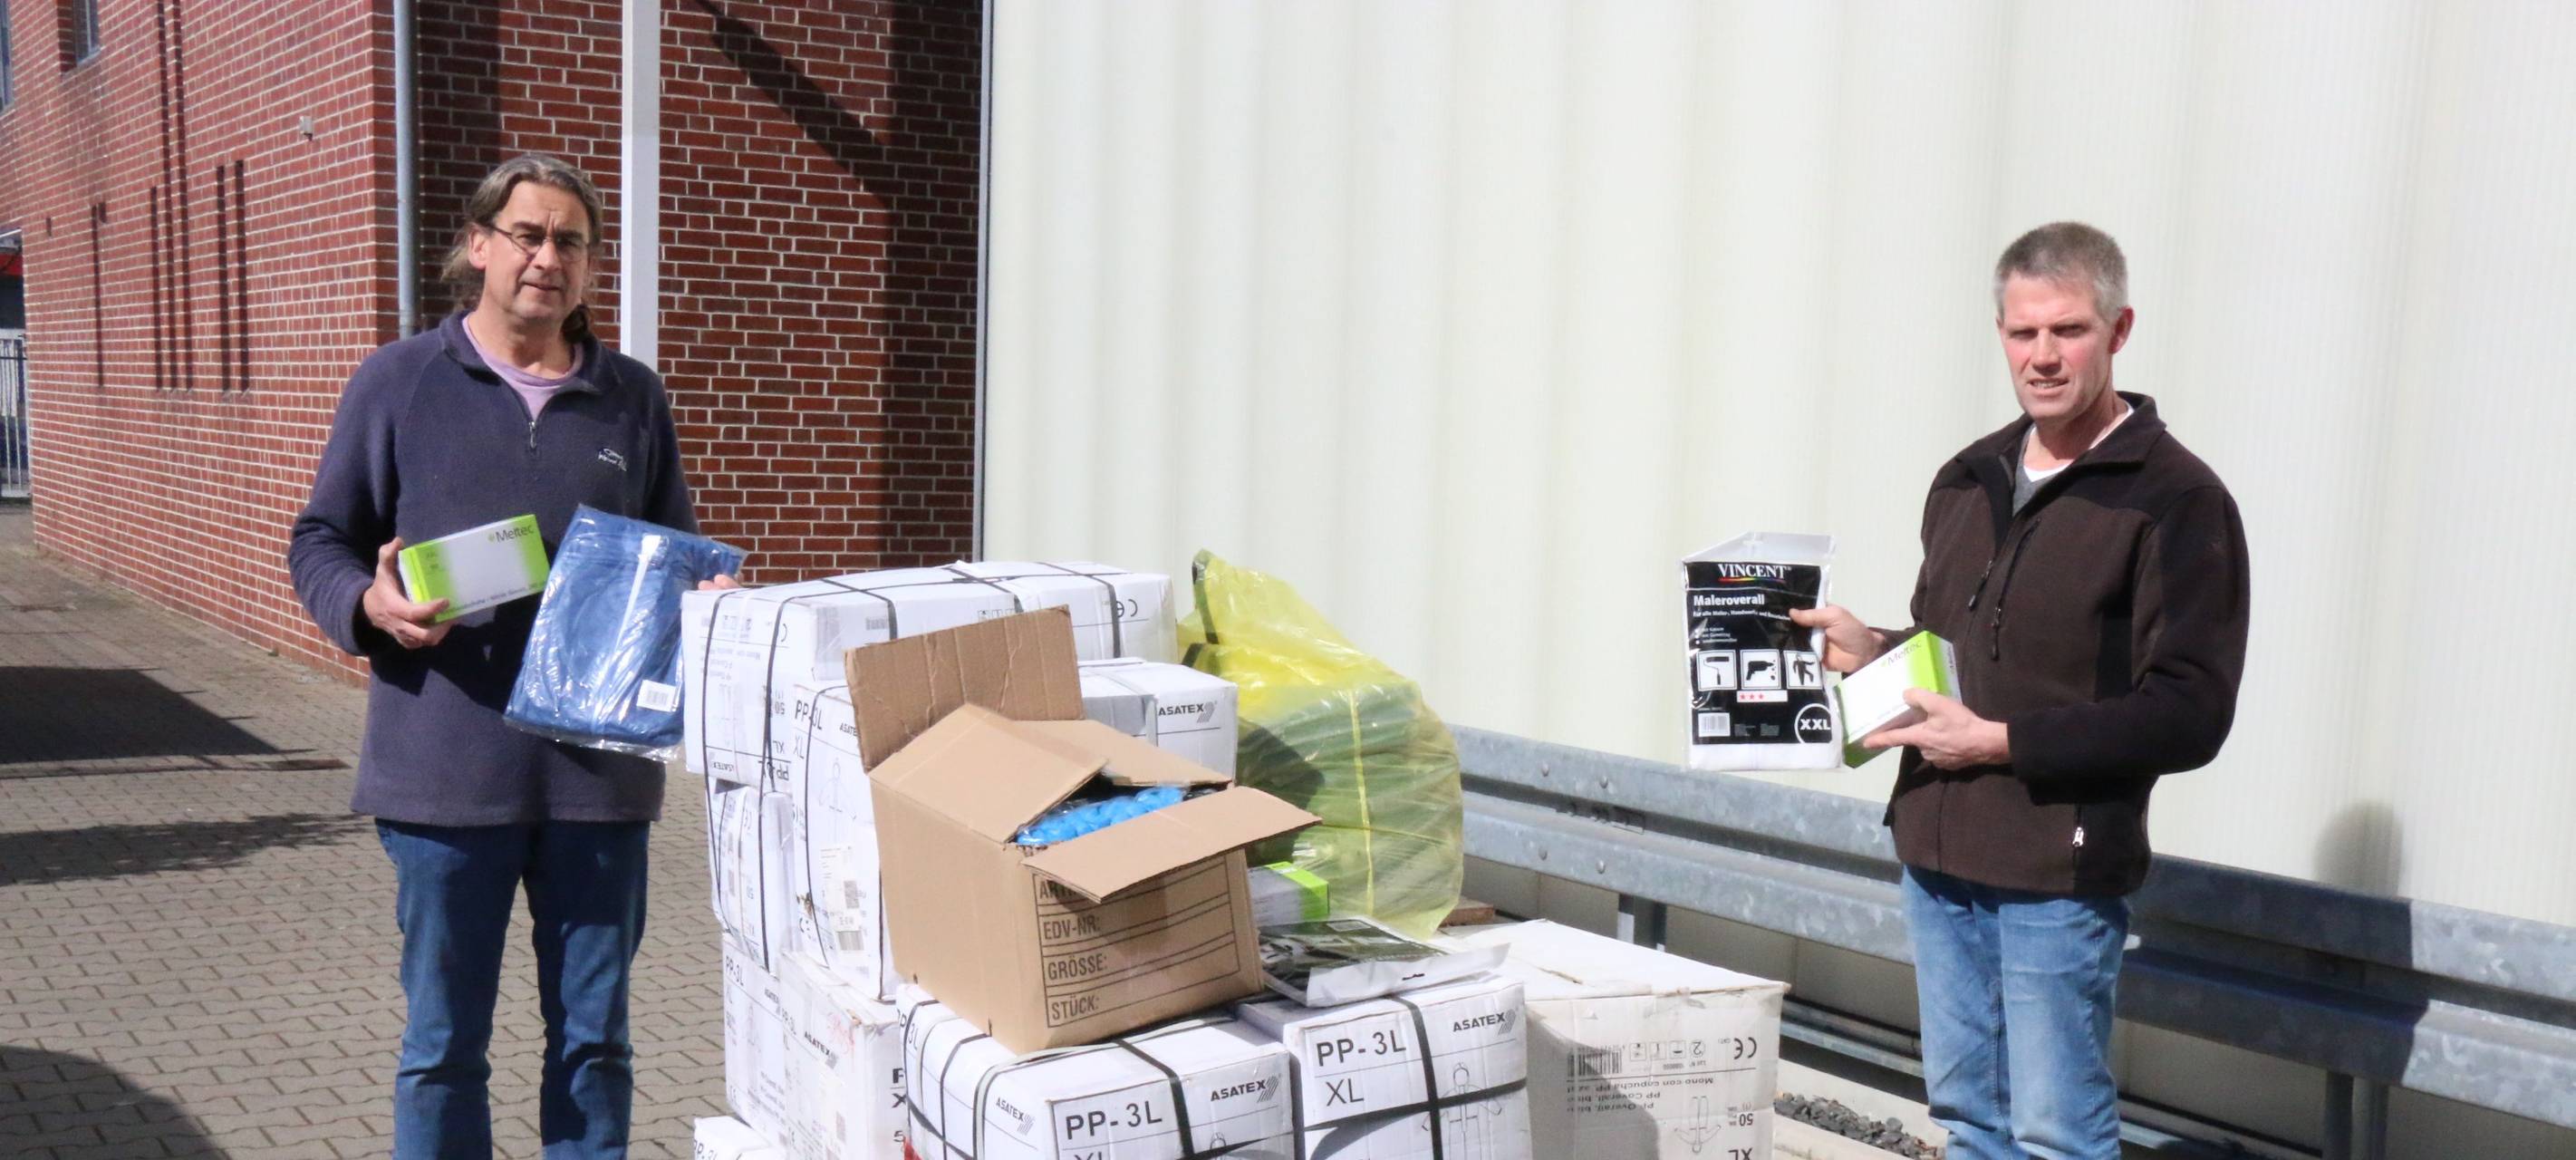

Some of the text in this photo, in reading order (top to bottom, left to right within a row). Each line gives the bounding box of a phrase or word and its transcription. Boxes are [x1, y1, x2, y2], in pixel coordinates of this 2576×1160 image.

[496, 525, 535, 543] Meltec
[1717, 563, 1787, 579] VINCENT
[1693, 594, 1765, 606] Maleroverall
[1158, 703, 1204, 717] ASATEX
[839, 722, 859, 738] ASATE
[1799, 719, 1831, 731] XXL
[1044, 914, 1101, 940] EDV-NR:
[1047, 952, 1108, 981] GRÖSSE:
[1051, 995, 1100, 1021] STÜCK:
[1452, 1013, 1506, 1033] ASATEX
[1211, 1078, 1267, 1102] ASATEX
[1685, 1077, 1714, 1085] Mono
[1327, 1078, 1365, 1107] XL
[996, 1097, 1025, 1123] ASATEX
[1739, 1112, 1754, 1127] 50
